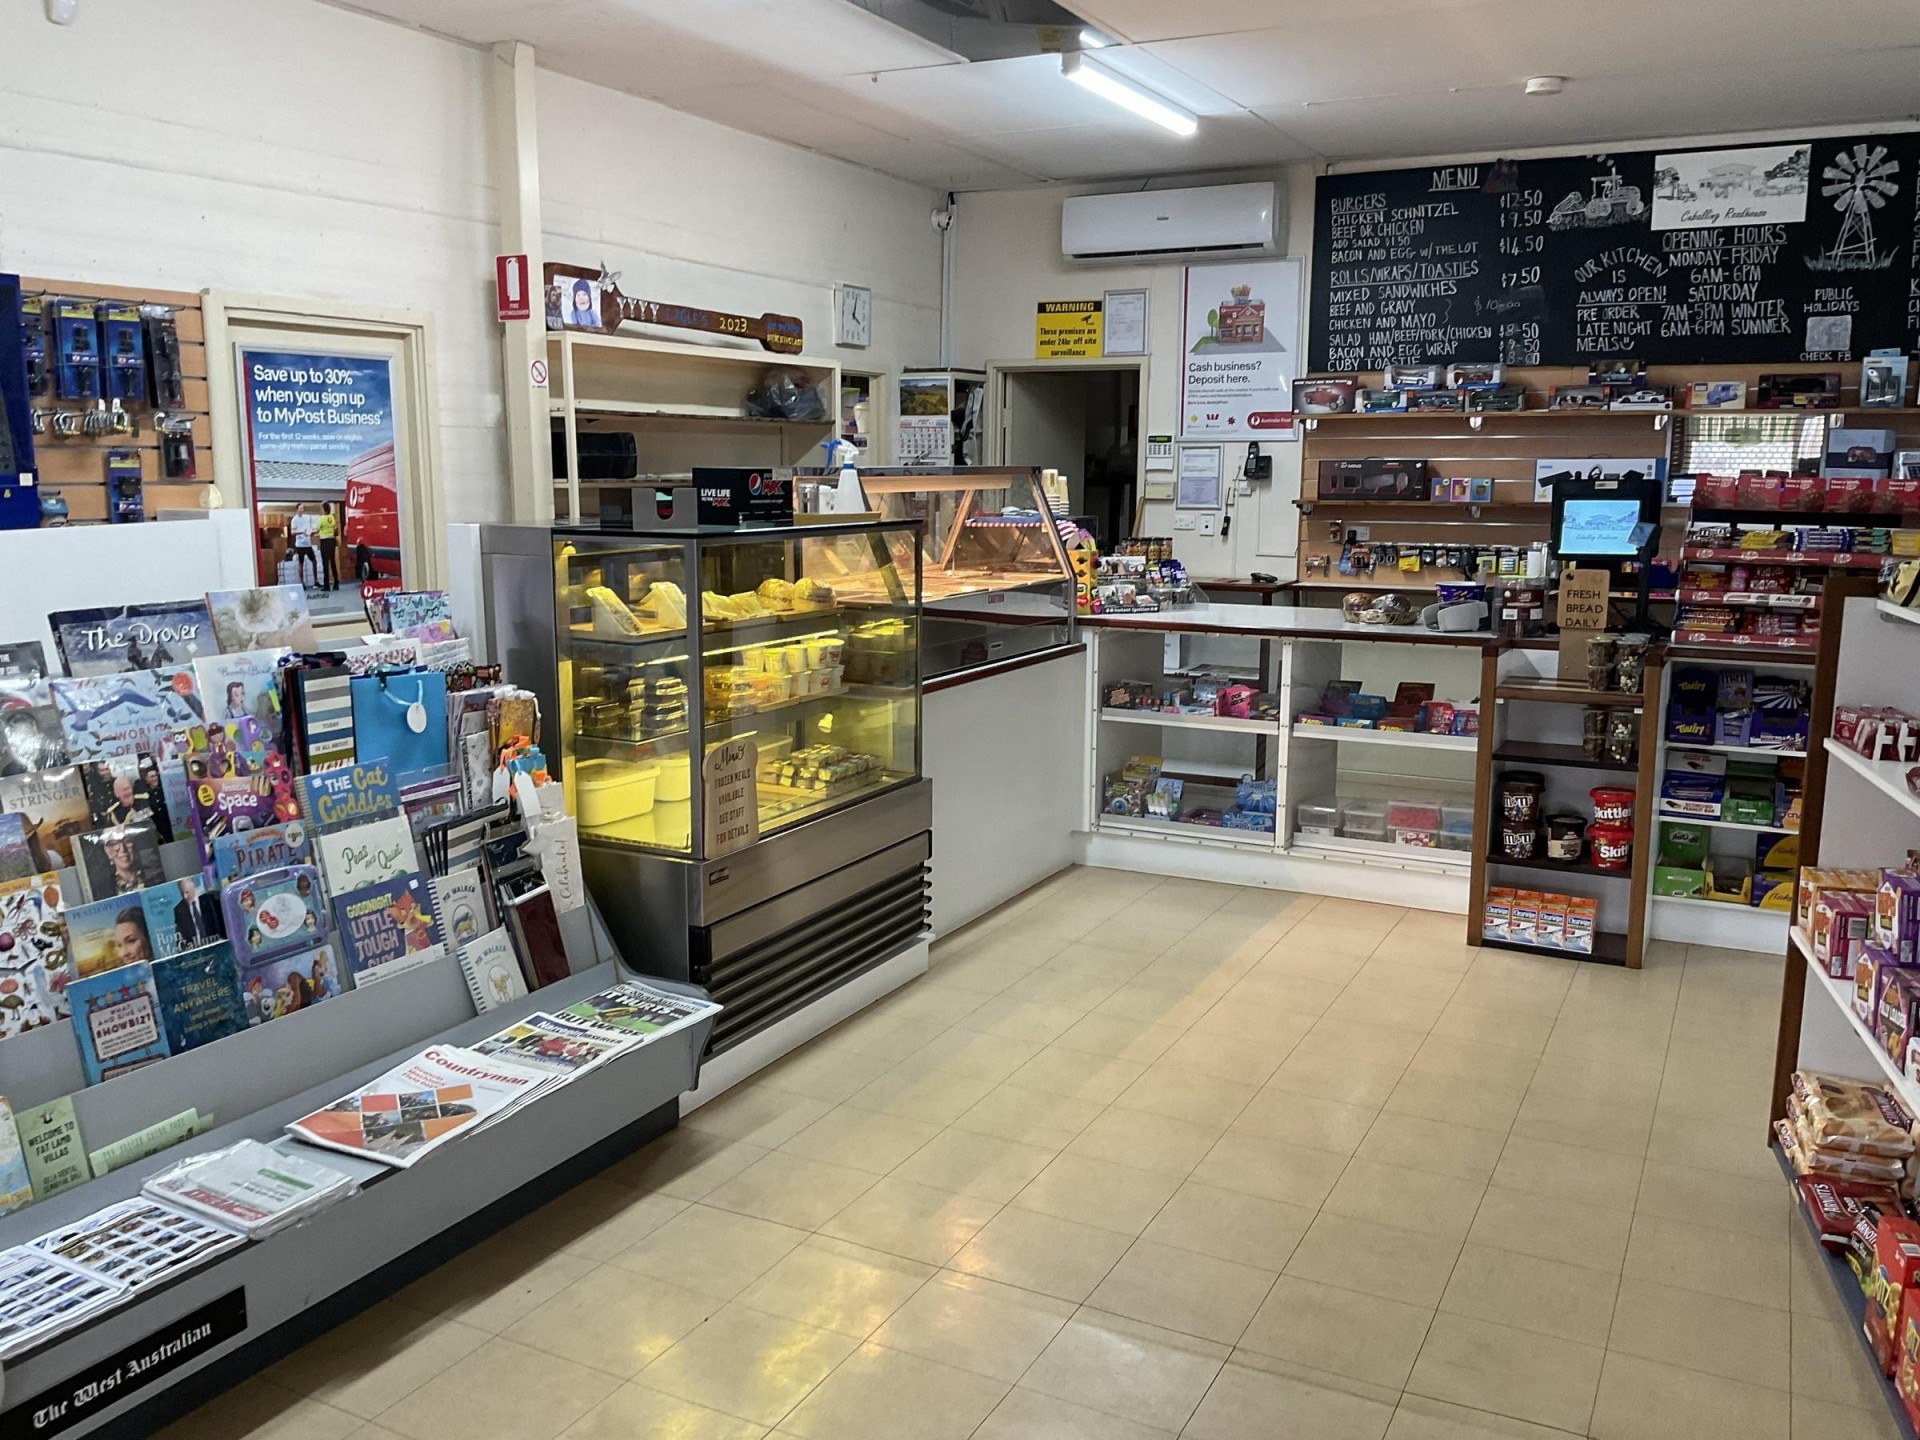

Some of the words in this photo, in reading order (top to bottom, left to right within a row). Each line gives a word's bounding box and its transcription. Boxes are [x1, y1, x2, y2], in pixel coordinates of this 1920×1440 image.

[1432, 167, 1478, 189] MENU
[1331, 193, 1387, 213] BURGERS
[1331, 211, 1384, 227] CHICKEN
[1391, 203, 1459, 222] SCHNITZEL
[1331, 226, 1356, 239] BEEF
[1360, 225, 1374, 237] OR
[1377, 219, 1425, 237] CHICKEN
[1662, 229, 1725, 250] OPENING
[1734, 225, 1787, 244] HOURS
[1332, 239, 1348, 249] ADD
[1351, 237, 1380, 248] SALAD
[1331, 250, 1362, 264] BACON
[1367, 248, 1386, 261] AND
[1390, 247, 1416, 260] EGG
[1435, 244, 1457, 255] THE
[1458, 241, 1478, 253] LOT
[1575, 259, 1603, 282] OUR
[1600, 247, 1668, 278] KITCHEN
[1612, 270, 1626, 283] IS
[1330, 287, 1370, 303] MIXED
[1378, 280, 1457, 299] SANDWICHES
[1579, 288, 1624, 304] ALWAYS
[1629, 286, 1666, 303] OPEN!
[1689, 282, 1758, 302] SATURDAY
[1815, 287, 1853, 301] PUBLIC
[1046, 302, 1094, 312] WARNING
[1329, 304, 1351, 317] BEEF
[1355, 302, 1375, 315] AND
[1381, 299, 1416, 314] GRAVY
[1577, 308, 1597, 321] PRE
[1602, 305, 1640, 319] ORDER
[1731, 299, 1787, 318] WINTER
[1804, 300, 1860, 312] HOLIDAYS
[1329, 318, 1370, 331] CHICKEN
[1376, 316, 1396, 328] AND
[1402, 313, 1436, 328] MAYO
[1577, 322, 1610, 336] LATE
[1614, 320, 1652, 335] NIGHT
[1732, 318, 1791, 335] SUMMER
[1058, 328, 1085, 336] premises
[1329, 334, 1361, 347] SALAD
[1040, 338, 1056, 346] under
[1073, 337, 1083, 345] off
[1329, 346, 1364, 359] BACON
[1370, 344, 1394, 357] AND
[1398, 345, 1423, 356] EGG
[1426, 342, 1458, 355] WRAP
[1577, 337, 1619, 351] MEALS
[1328, 358, 1360, 372] CUBY
[1800, 352, 1832, 362] CHECK
[1838, 351, 1851, 361] FB
[254, 365, 287, 380] Save
[290, 372, 307, 385] up
[310, 368, 323, 383] to
[325, 369, 353, 384] 30%
[1189, 362, 1213, 372] Cash
[1214, 360, 1262, 372] business?
[1188, 374, 1224, 386] Deposit
[1226, 374, 1251, 384] here.
[255, 386, 293, 402] when
[295, 391, 319, 406] you
[321, 388, 347, 406] sign
[350, 394, 365, 408] up
[257, 407, 271, 422] to
[274, 408, 325, 426] MyPost
[701, 489, 716, 497] LIVE
[717, 489, 730, 497] LIFE
[1567, 590, 1600, 599] FRESH
[1566, 604, 1603, 613] BREAD
[1565, 618, 1599, 627] DAILY
[82, 624, 130, 651] The
[129, 622, 199, 645] Drover
[1676, 723, 1705, 735] Twirl
[715, 744, 745, 771] Menu
[324, 775, 352, 793] THE
[353, 766, 388, 790] Cat
[715, 775, 733, 789] FROZEN
[735, 768, 750, 782] MEALS
[10, 787, 81, 810] STRINGER
[218, 792, 257, 814] Space
[719, 787, 744, 805] AVAILABLE
[318, 789, 393, 824] Cuddles
[719, 813, 728, 825] SEE
[730, 806, 745, 821] STAFF
[717, 830, 727, 845] FOR
[728, 824, 749, 840] DETAILS
[236, 842, 296, 871] PIRATE
[341, 846, 369, 874] Peas
[452, 885, 475, 894] WALKER
[351, 910, 393, 937] LITTLE
[156, 931, 182, 946] Ron
[354, 931, 399, 962] TOUGH
[484, 945, 507, 956] WALKER
[181, 977, 218, 995] TRAVEL
[174, 986, 231, 1013] ANYWHERE
[98, 1018, 115, 1026] AND
[555, 1012, 587, 1026] BUT
[425, 1051, 530, 1086] Countryman
[28, 1125, 63, 1147] WELCOME
[65, 1121, 74, 1131] TO
[36, 1144, 50, 1156] FAT
[52, 1134, 72, 1150] LAMB
[43, 1147, 69, 1164] VILLAS
[33, 1397, 68, 1429] The
[73, 1368, 122, 1408] West
[125, 1320, 212, 1380] Australian
